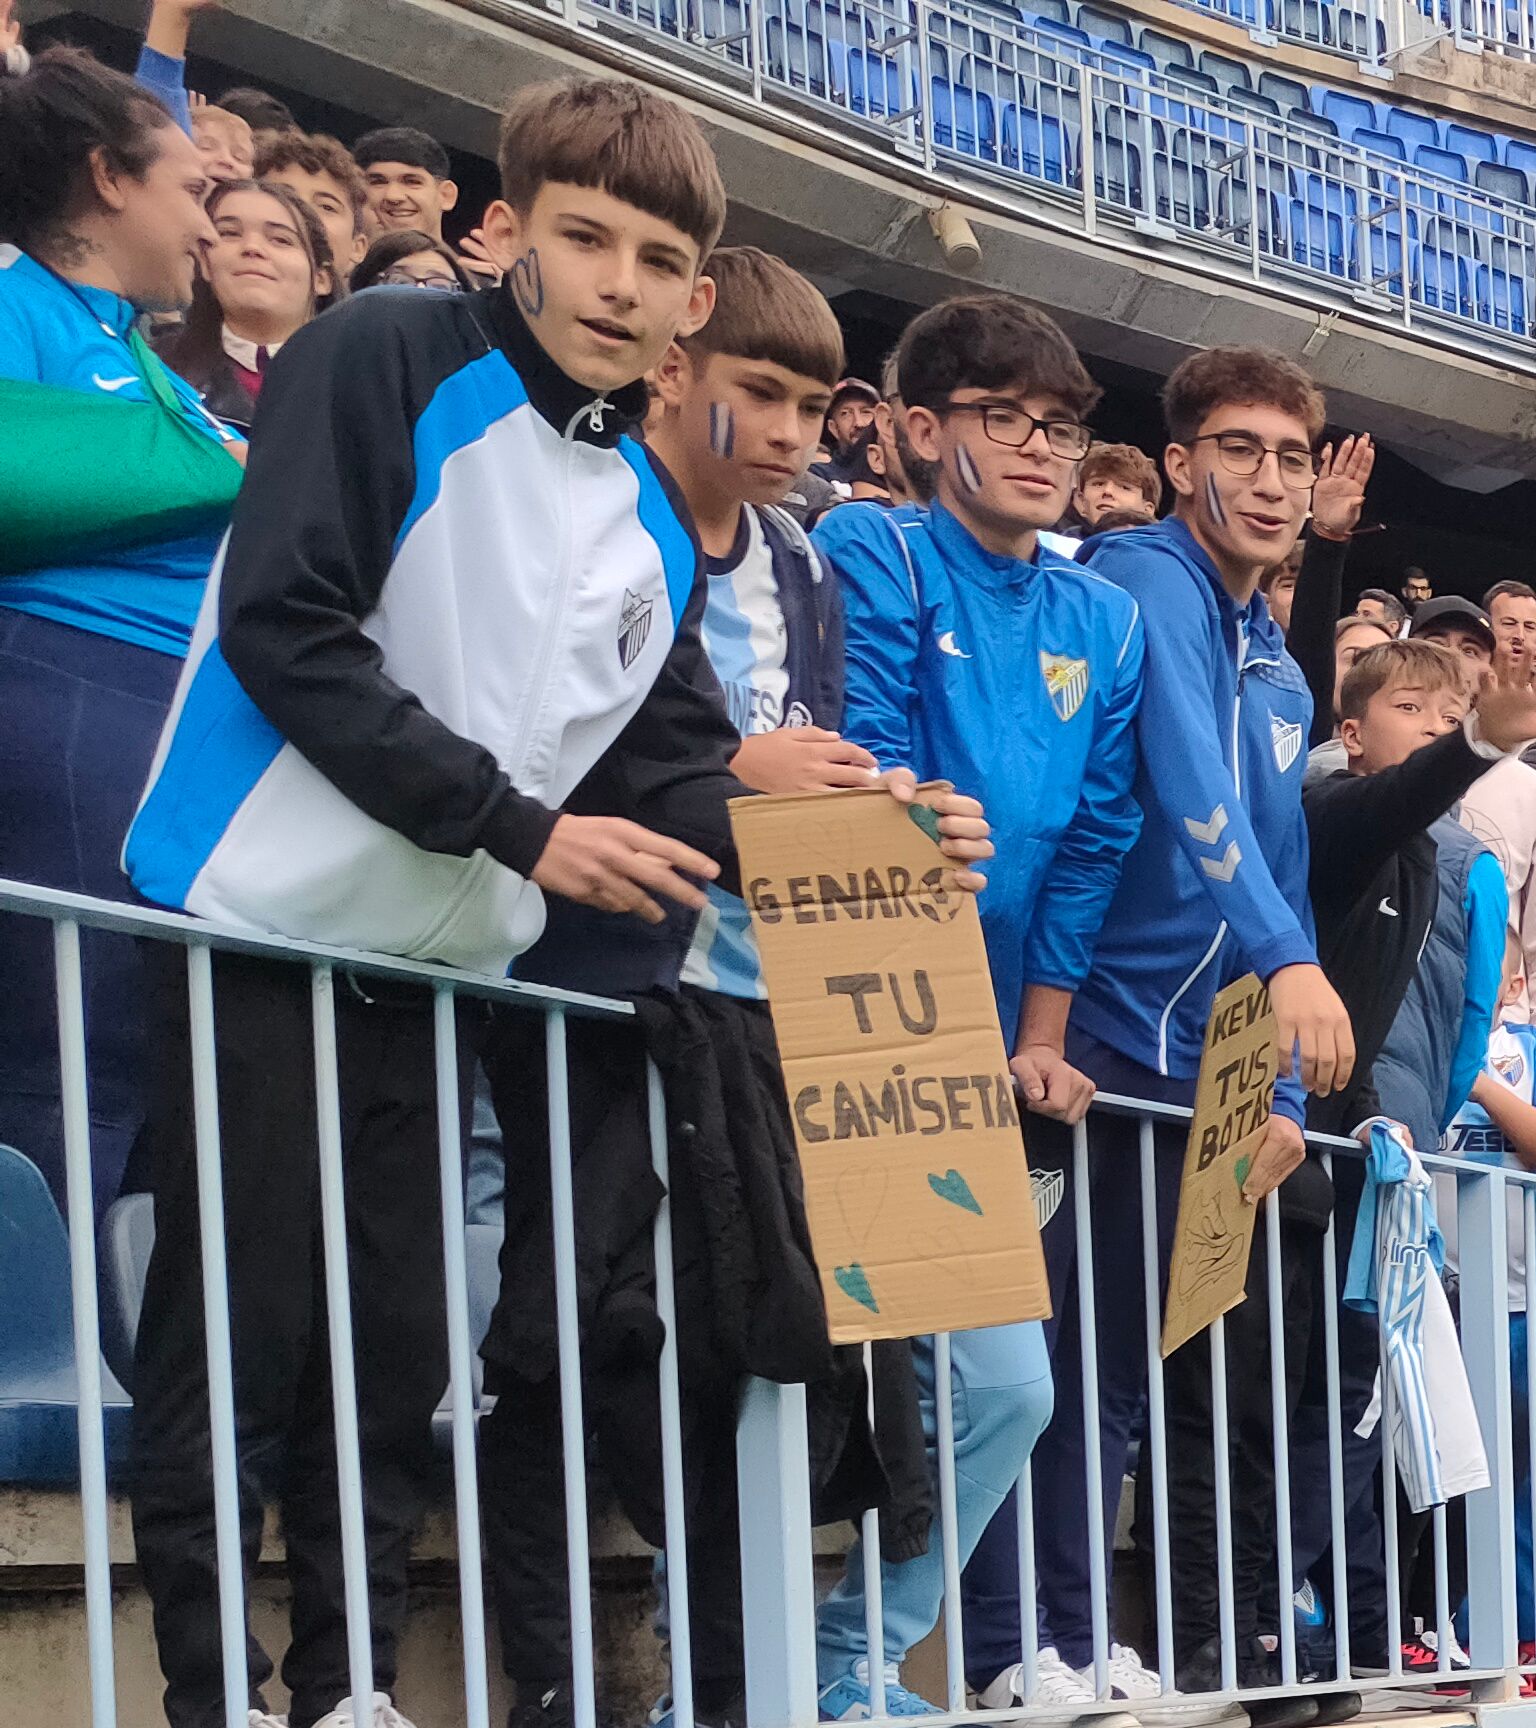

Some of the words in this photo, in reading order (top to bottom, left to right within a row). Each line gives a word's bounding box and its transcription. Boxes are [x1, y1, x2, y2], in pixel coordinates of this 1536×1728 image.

[824, 969, 938, 1036] TU
[1215, 1041, 1271, 1108] TUS
[1197, 1080, 1275, 1173] BOTAS
